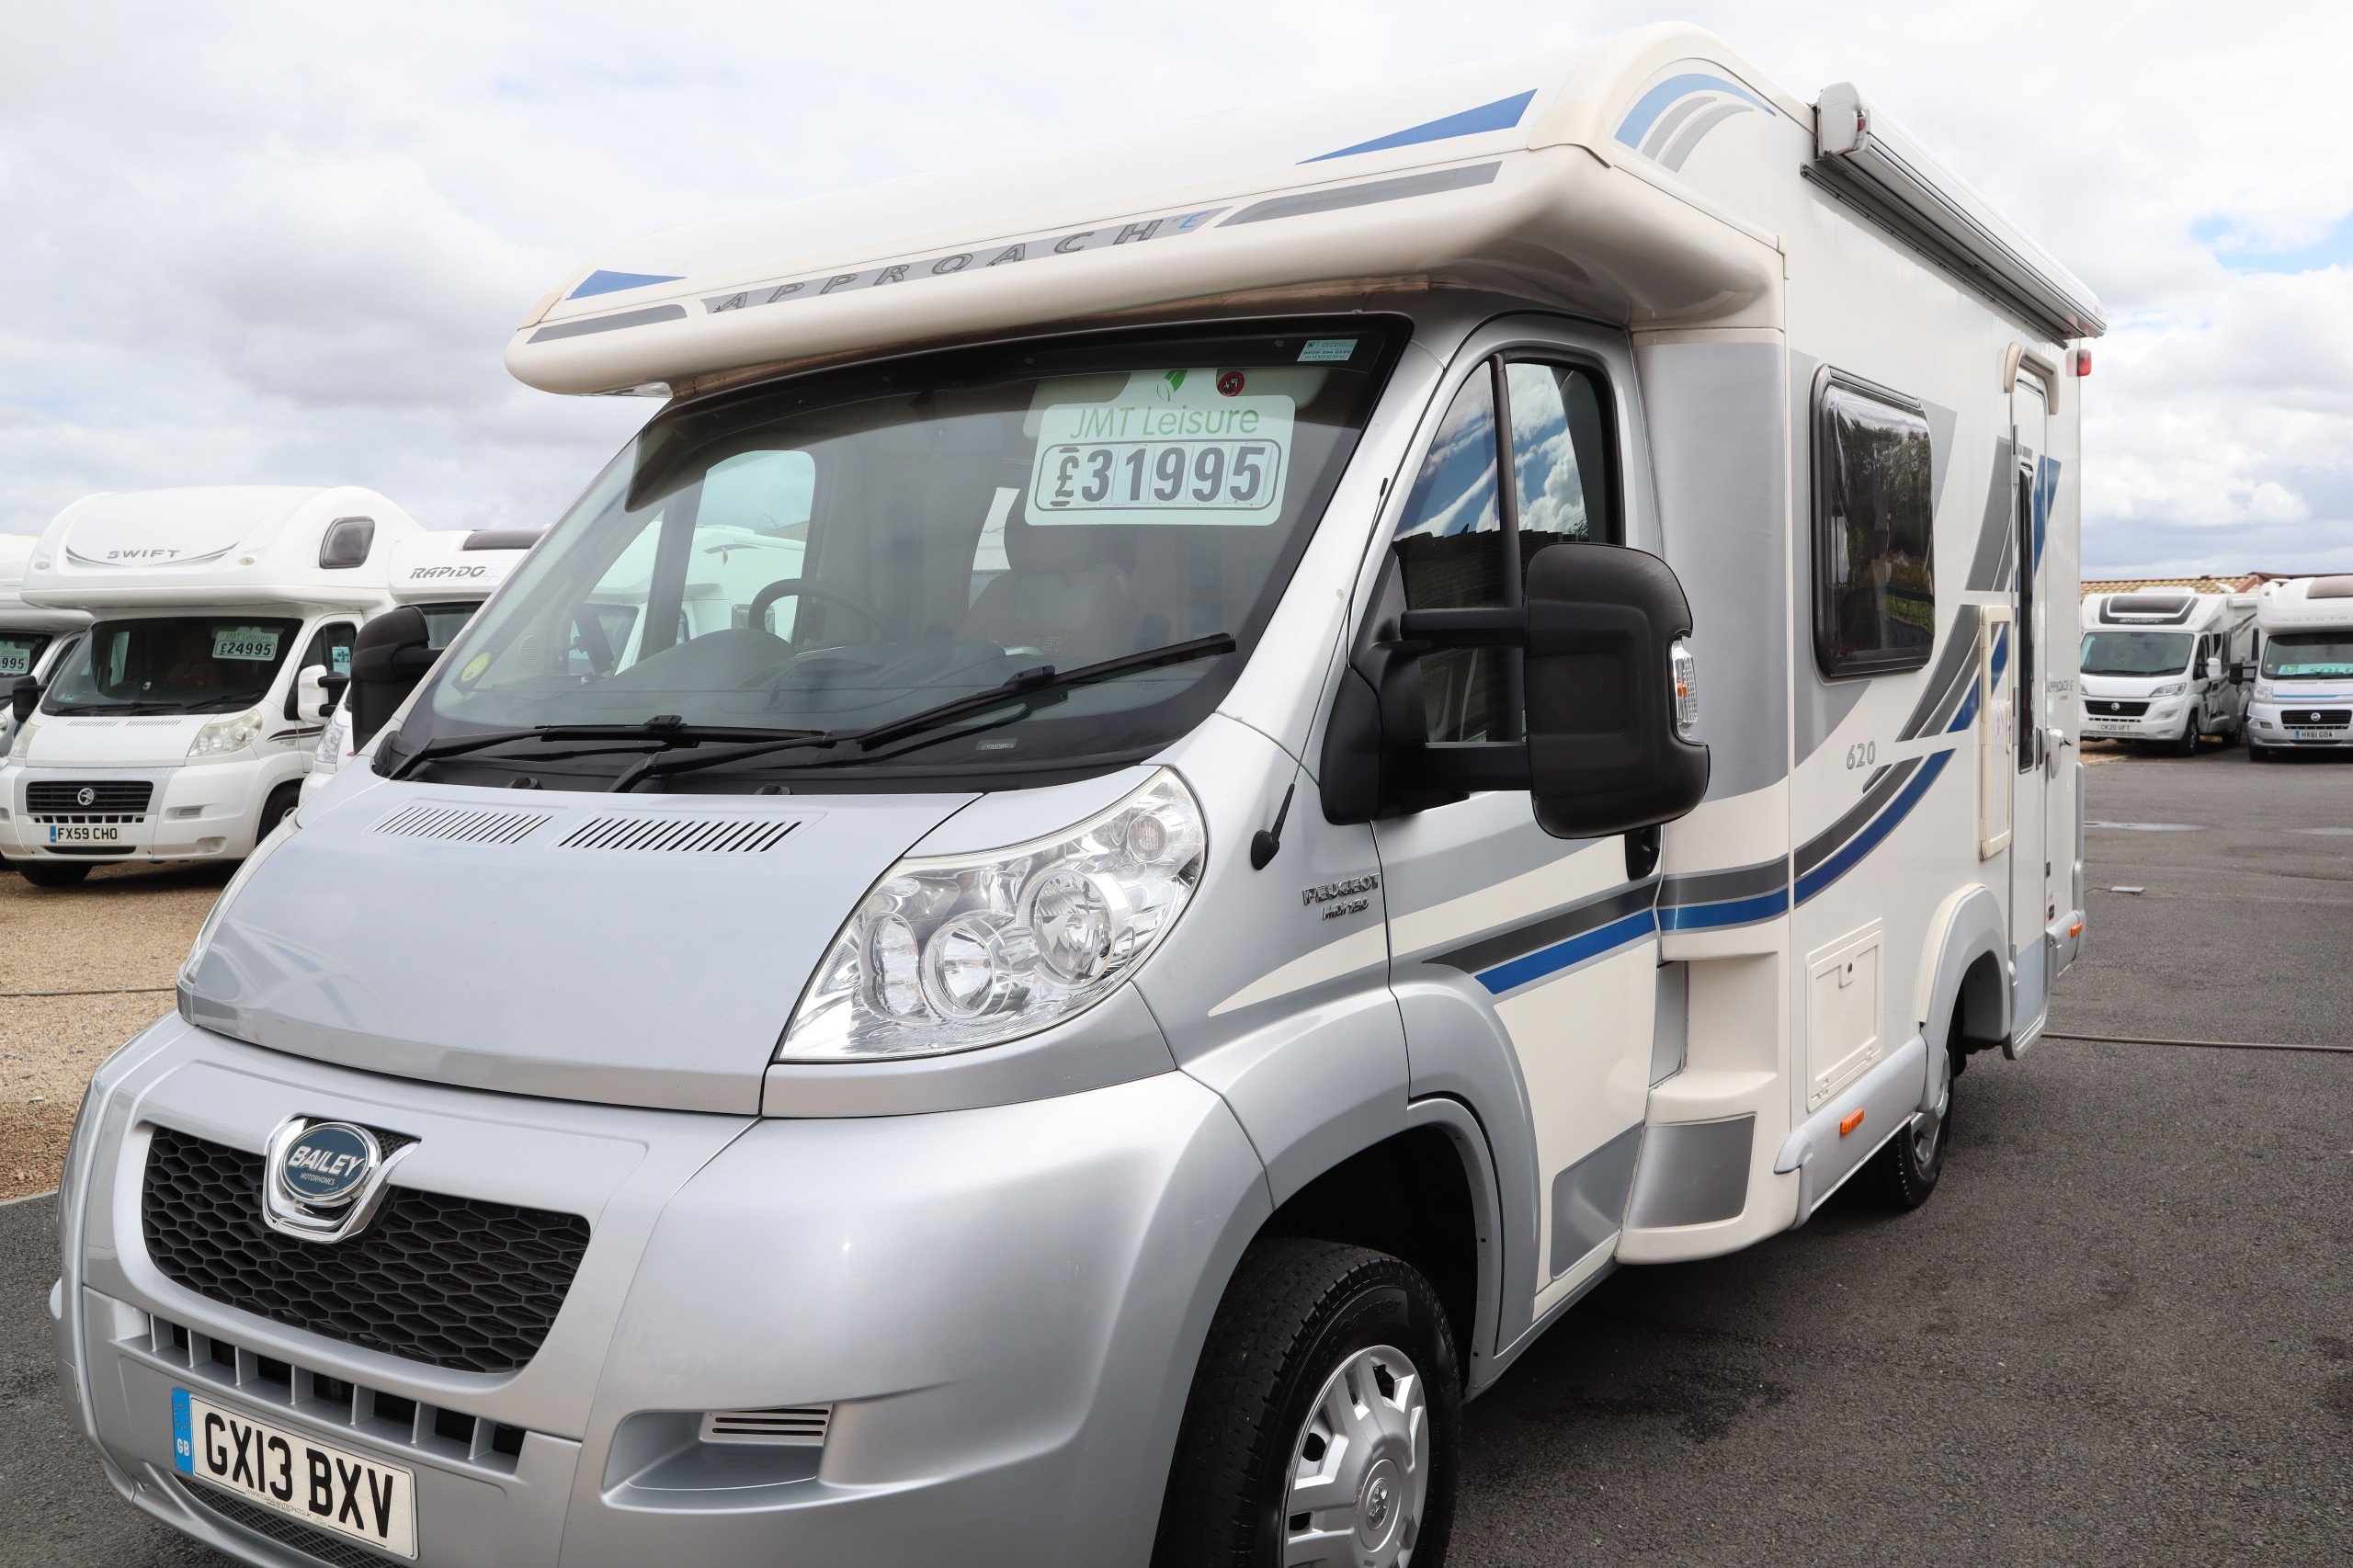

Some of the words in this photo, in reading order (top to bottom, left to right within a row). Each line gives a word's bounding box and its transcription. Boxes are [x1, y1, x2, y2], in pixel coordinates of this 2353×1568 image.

[712, 219, 1164, 313] APPROACH
[1070, 407, 1136, 439] JMT
[1142, 404, 1259, 436] Leisure
[1054, 447, 1266, 503] £31995
[107, 550, 180, 559] SWIFT
[409, 566, 487, 579] RAPIDO
[243, 633, 271, 642] Leisure
[220, 642, 272, 656] £24995
[1, 657, 25, 670] 995
[1847, 741, 1876, 770] 620
[58, 828, 90, 839] FX59
[93, 828, 118, 839] CHO
[1302, 873, 1380, 905] PEUGEOT
[288, 1145, 364, 1177] BAILEY
[300, 1172, 336, 1186] MOTORHOMES
[176, 1437, 190, 1457] GB
[205, 1412, 293, 1502] GX13
[306, 1448, 393, 1540] BXV
